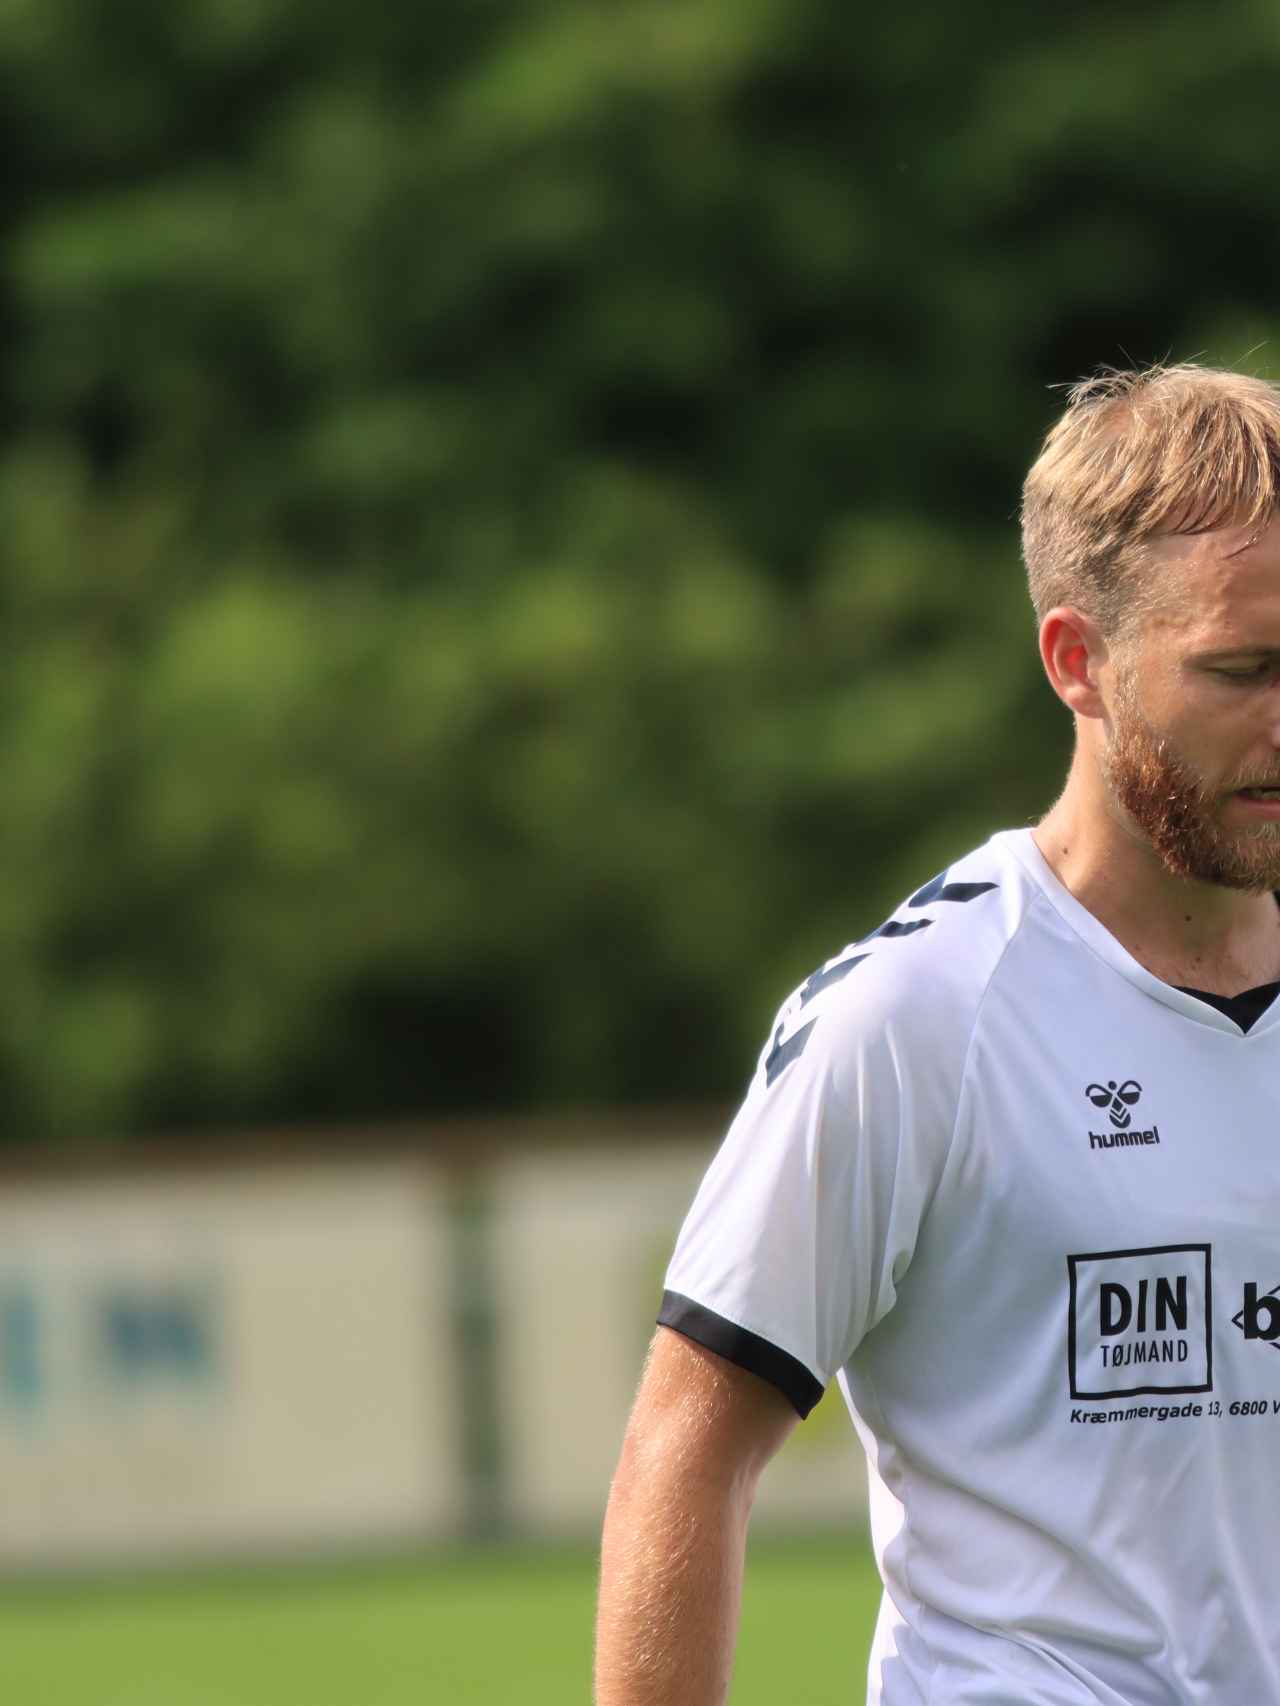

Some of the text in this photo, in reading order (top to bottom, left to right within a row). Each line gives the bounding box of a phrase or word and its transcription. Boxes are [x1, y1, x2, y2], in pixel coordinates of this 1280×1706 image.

[1088, 1126, 1160, 1149] hummel
[1100, 1275, 1188, 1336] DIN
[1100, 1339, 1188, 1367] TØJMAND
[1070, 1402, 1203, 1424] Kræmmergade
[1208, 1401, 1223, 1418] 13,
[1229, 1400, 1267, 1416] 6800
